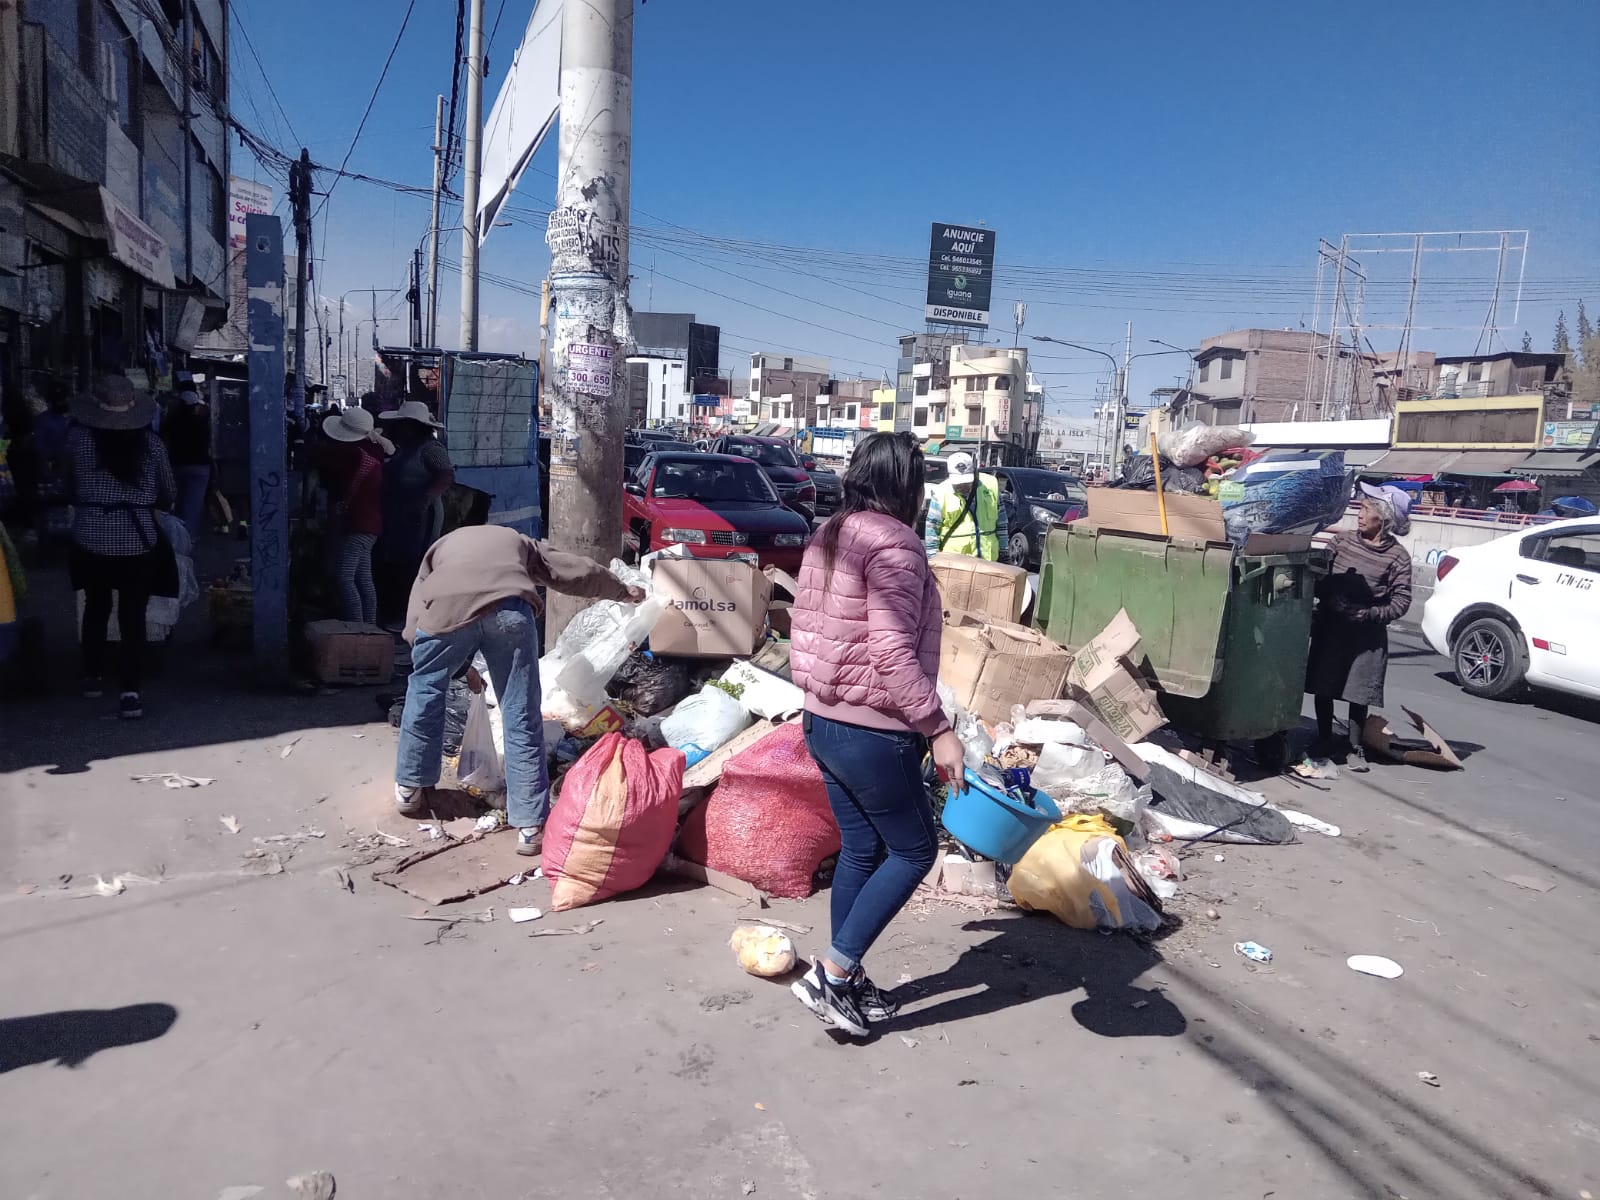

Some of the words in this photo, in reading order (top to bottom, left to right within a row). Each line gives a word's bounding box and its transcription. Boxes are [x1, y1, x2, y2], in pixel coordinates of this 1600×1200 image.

[943, 228, 985, 243] ANUNCIE
[951, 241, 975, 253] AQUÍ
[946, 288, 972, 299] iguana
[933, 307, 982, 321] DISPONIBLE
[569, 345, 613, 358] URGENTE
[571, 372, 588, 383] 300
[594, 375, 610, 386] 650
